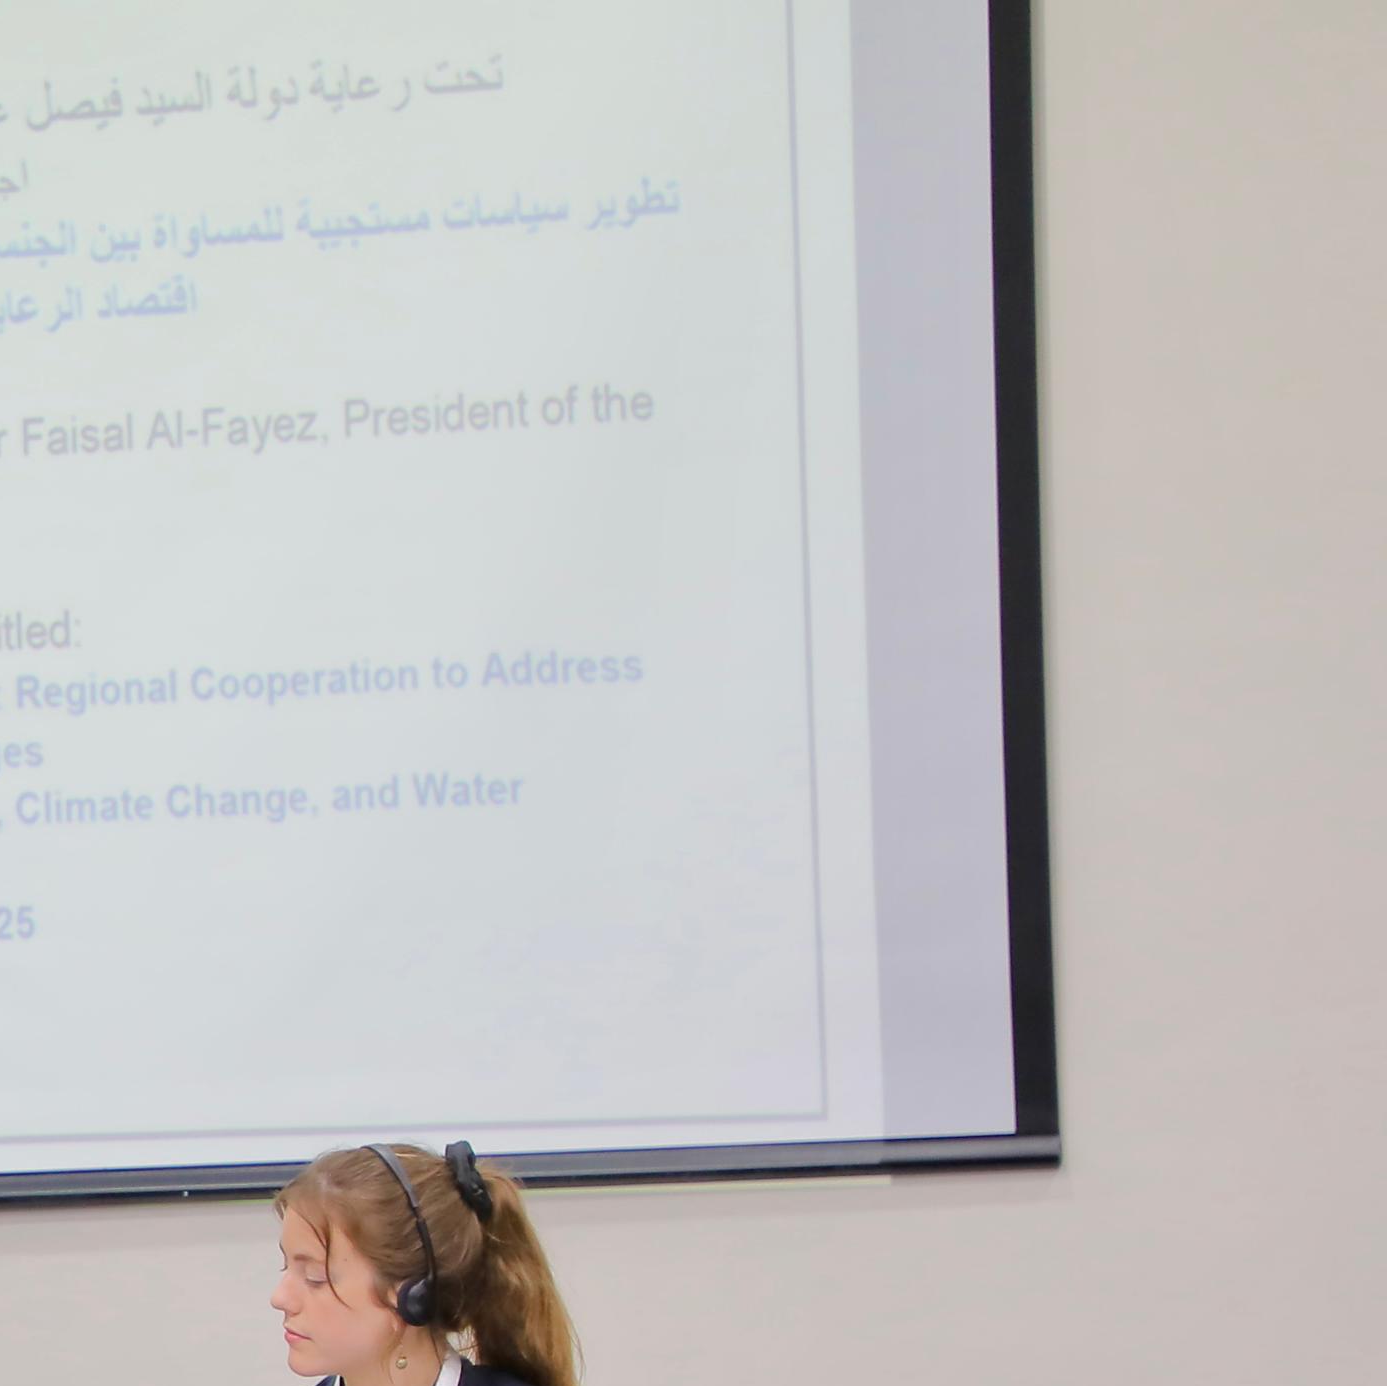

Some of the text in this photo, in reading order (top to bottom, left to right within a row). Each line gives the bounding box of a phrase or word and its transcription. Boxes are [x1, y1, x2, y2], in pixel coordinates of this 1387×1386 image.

[136, 70, 213, 126] السيد
[227, 66, 300, 121] دولة
[424, 54, 504, 94] تحت
[26, 77, 124, 131] فيصل
[442, 193, 570, 234] سياسات
[587, 176, 681, 230] تطوير
[90, 224, 142, 263] بين
[153, 206, 285, 258] للمساواة
[22, 412, 134, 456] Faisal
[146, 406, 328, 454] Al-Fayez,
[344, 391, 528, 438] President
[541, 384, 579, 425] of
[591, 383, 655, 423] the
[16, 668, 178, 717] Regional
[190, 660, 419, 706] Cooperation
[432, 657, 470, 688] to
[482, 650, 644, 686] Address
[15, 788, 155, 826] Climate
[166, 784, 318, 823] Change,
[332, 775, 401, 811] and
[413, 771, 523, 808] Water
